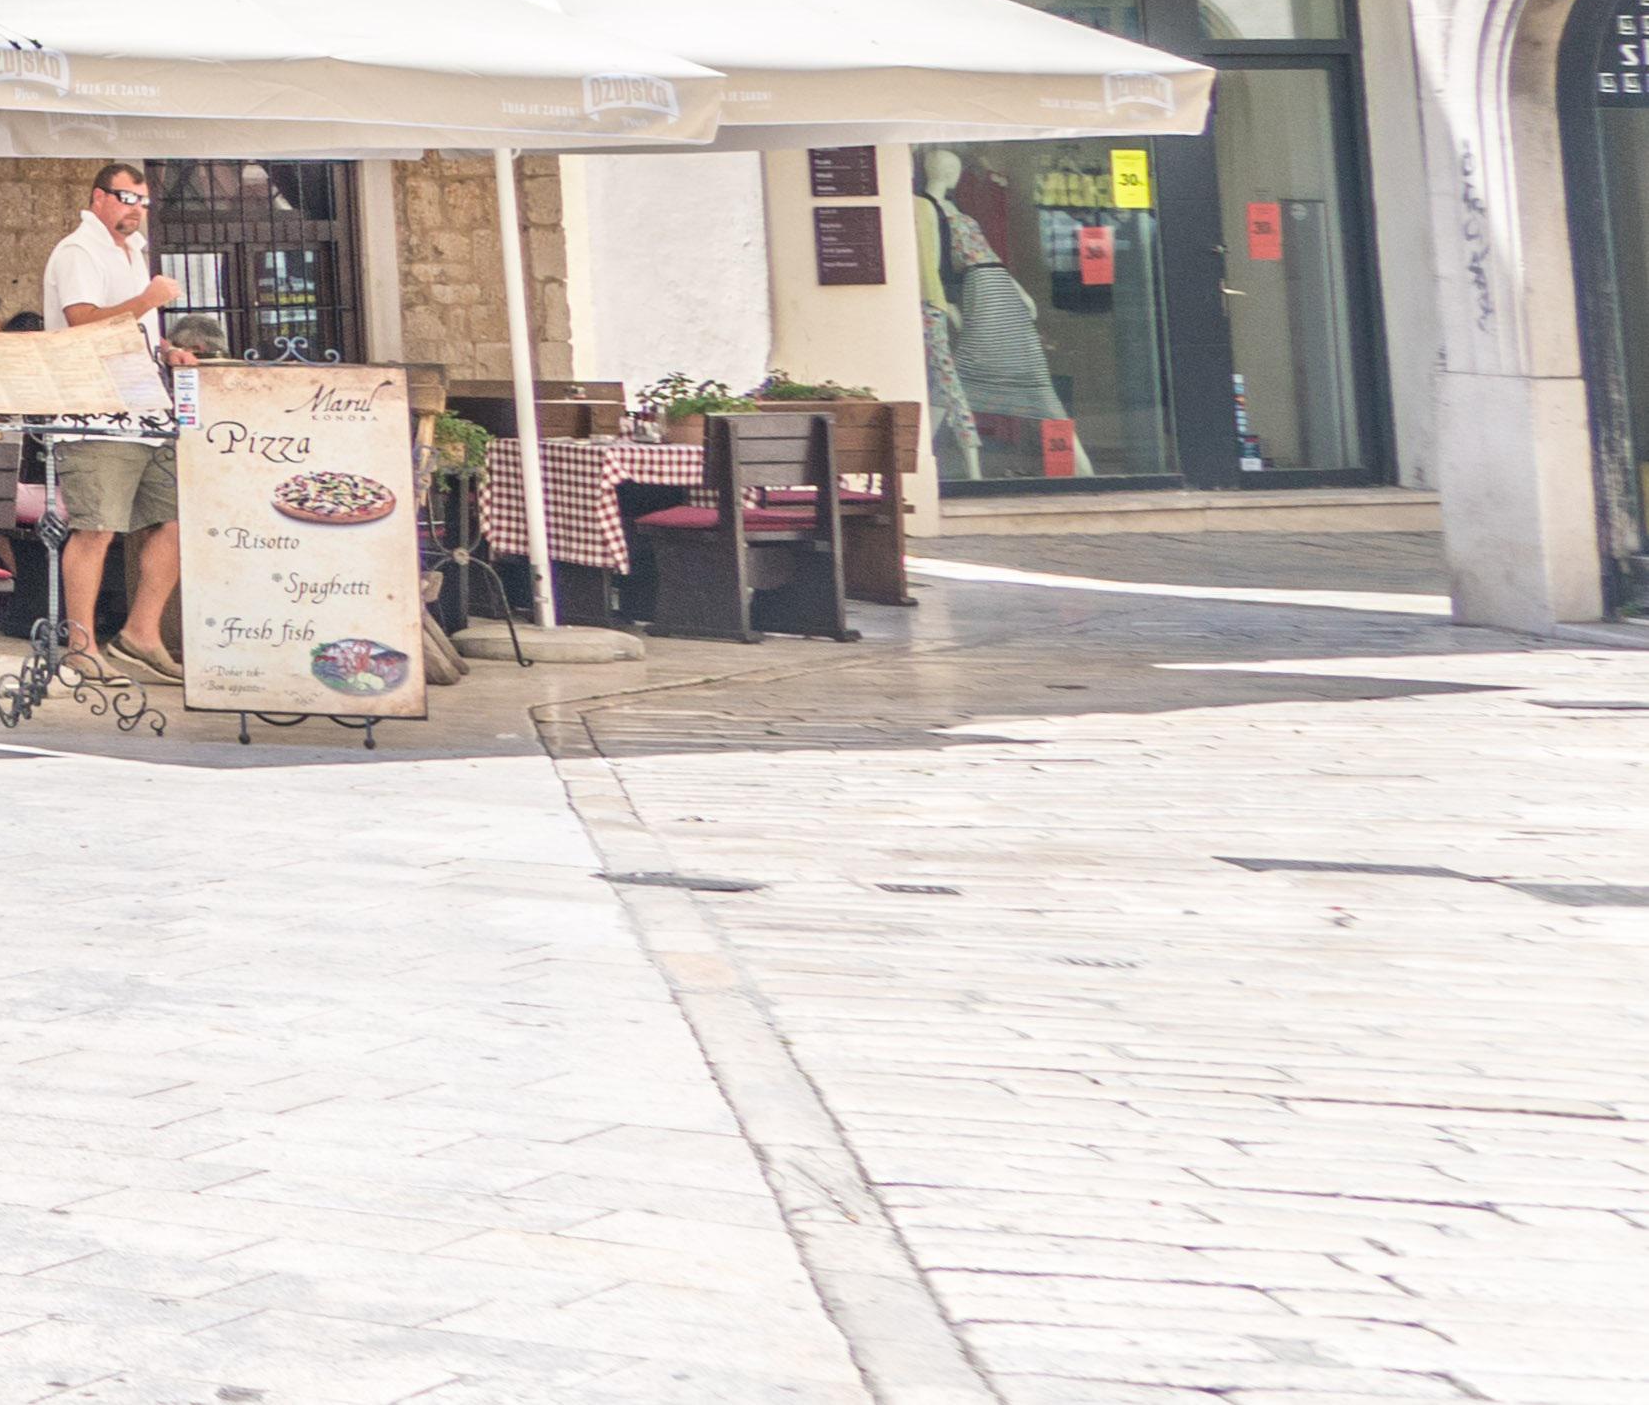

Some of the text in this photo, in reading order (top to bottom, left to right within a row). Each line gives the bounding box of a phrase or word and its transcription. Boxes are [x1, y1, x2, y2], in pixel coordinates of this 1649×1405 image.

[285, 380, 395, 414] Marul
[206, 421, 312, 464] Pizza
[225, 526, 301, 550] Risotto
[283, 571, 371, 605] Spaghetti
[220, 616, 315, 648] Fresh fish
